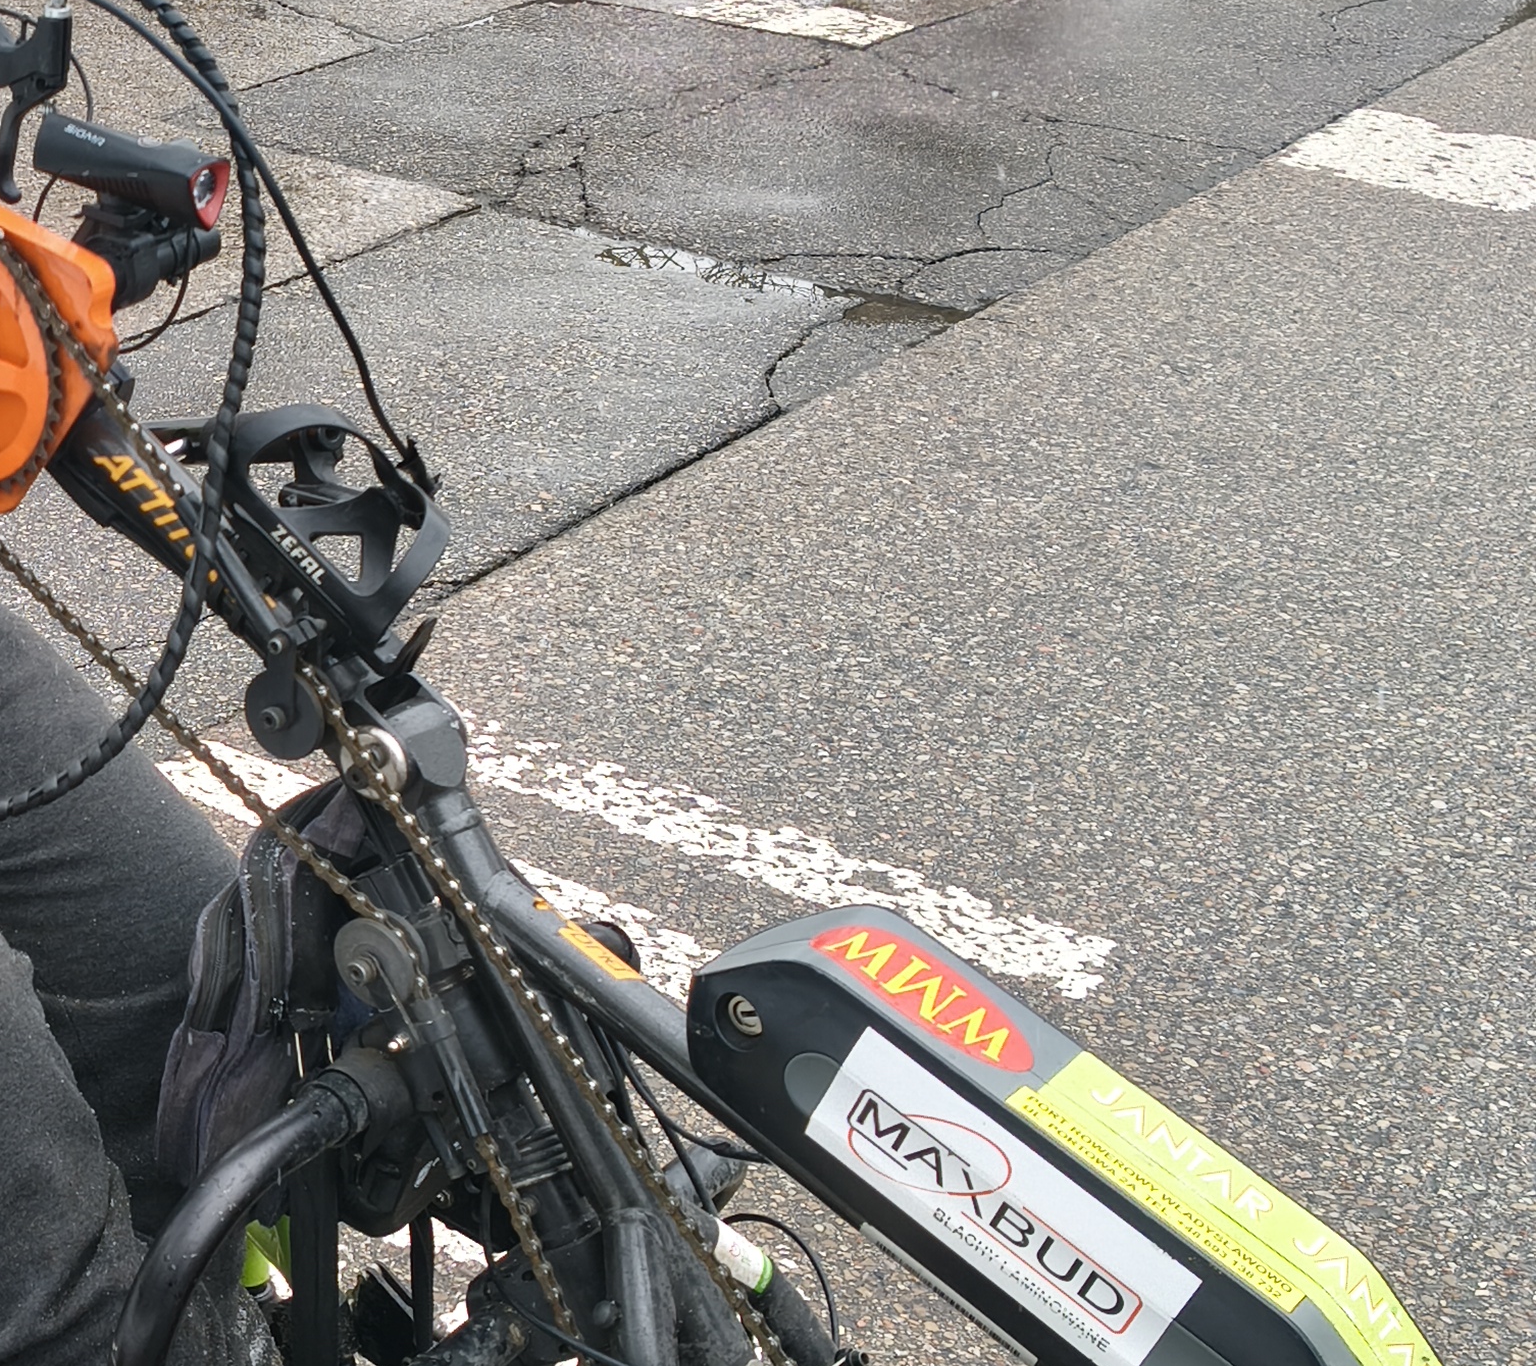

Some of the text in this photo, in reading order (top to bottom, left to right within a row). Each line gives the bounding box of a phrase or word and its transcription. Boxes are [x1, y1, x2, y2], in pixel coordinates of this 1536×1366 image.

[269, 523, 327, 586] ZEFAL
[1027, 1094, 1068, 1131] PORT
[1072, 1126, 1159, 1193] ROWEROWY
[1048, 1122, 1117, 1178] PORTOWA
[1118, 1174, 1137, 1192] 2A
[1256, 1275, 1282, 1300] 732
[1090, 1086, 1274, 1222] JANTAR
[932, 1206, 1111, 1354] BLACHY LAMINOWANE
